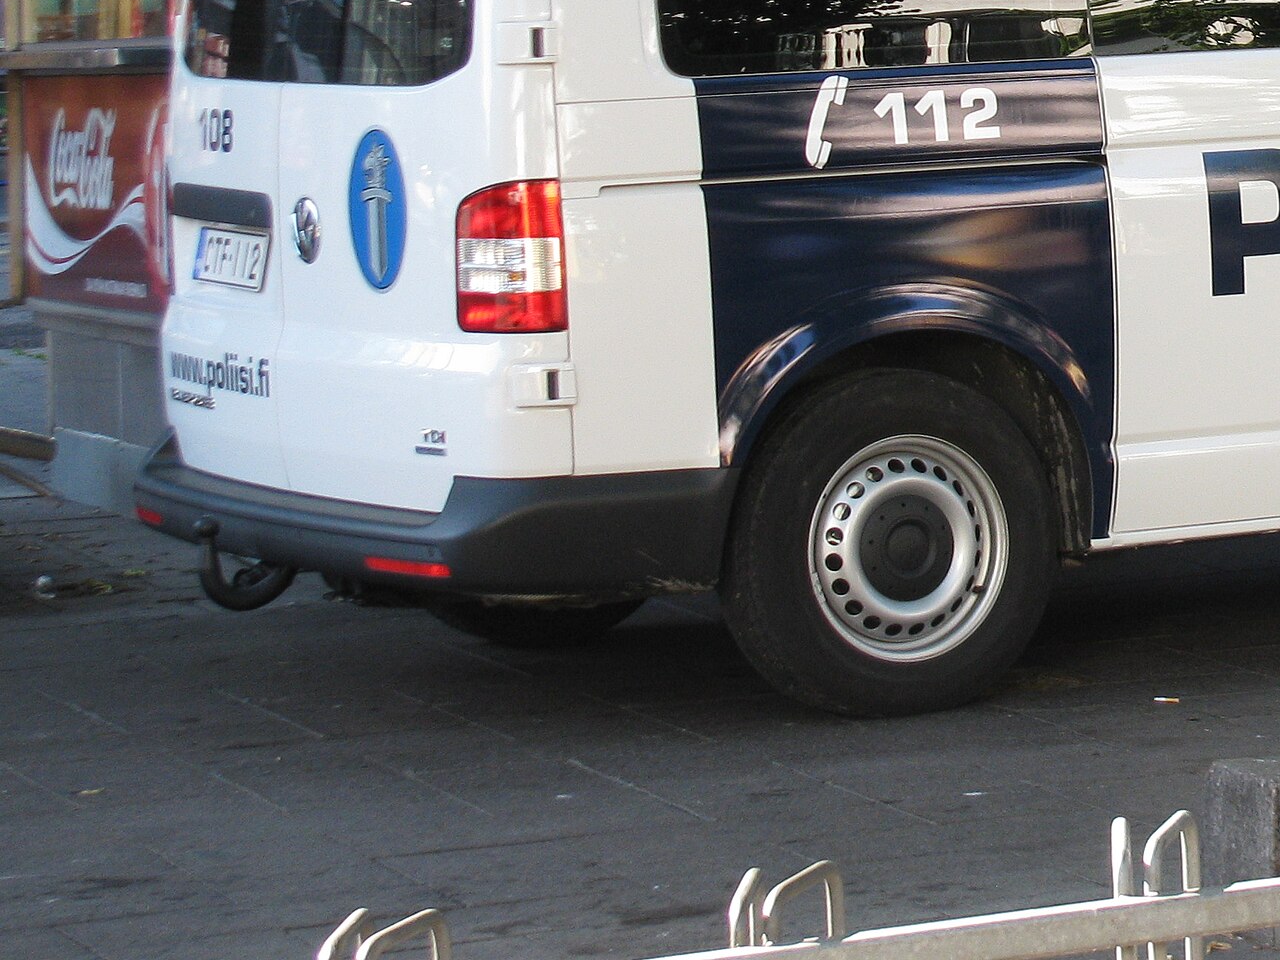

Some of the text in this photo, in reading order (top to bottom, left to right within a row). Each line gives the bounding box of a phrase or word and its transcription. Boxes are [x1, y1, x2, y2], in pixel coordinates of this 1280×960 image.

[199, 107, 233, 153] 108
[873, 87, 1001, 145] 112
[171, 351, 270, 398] www.poliisi.fi
